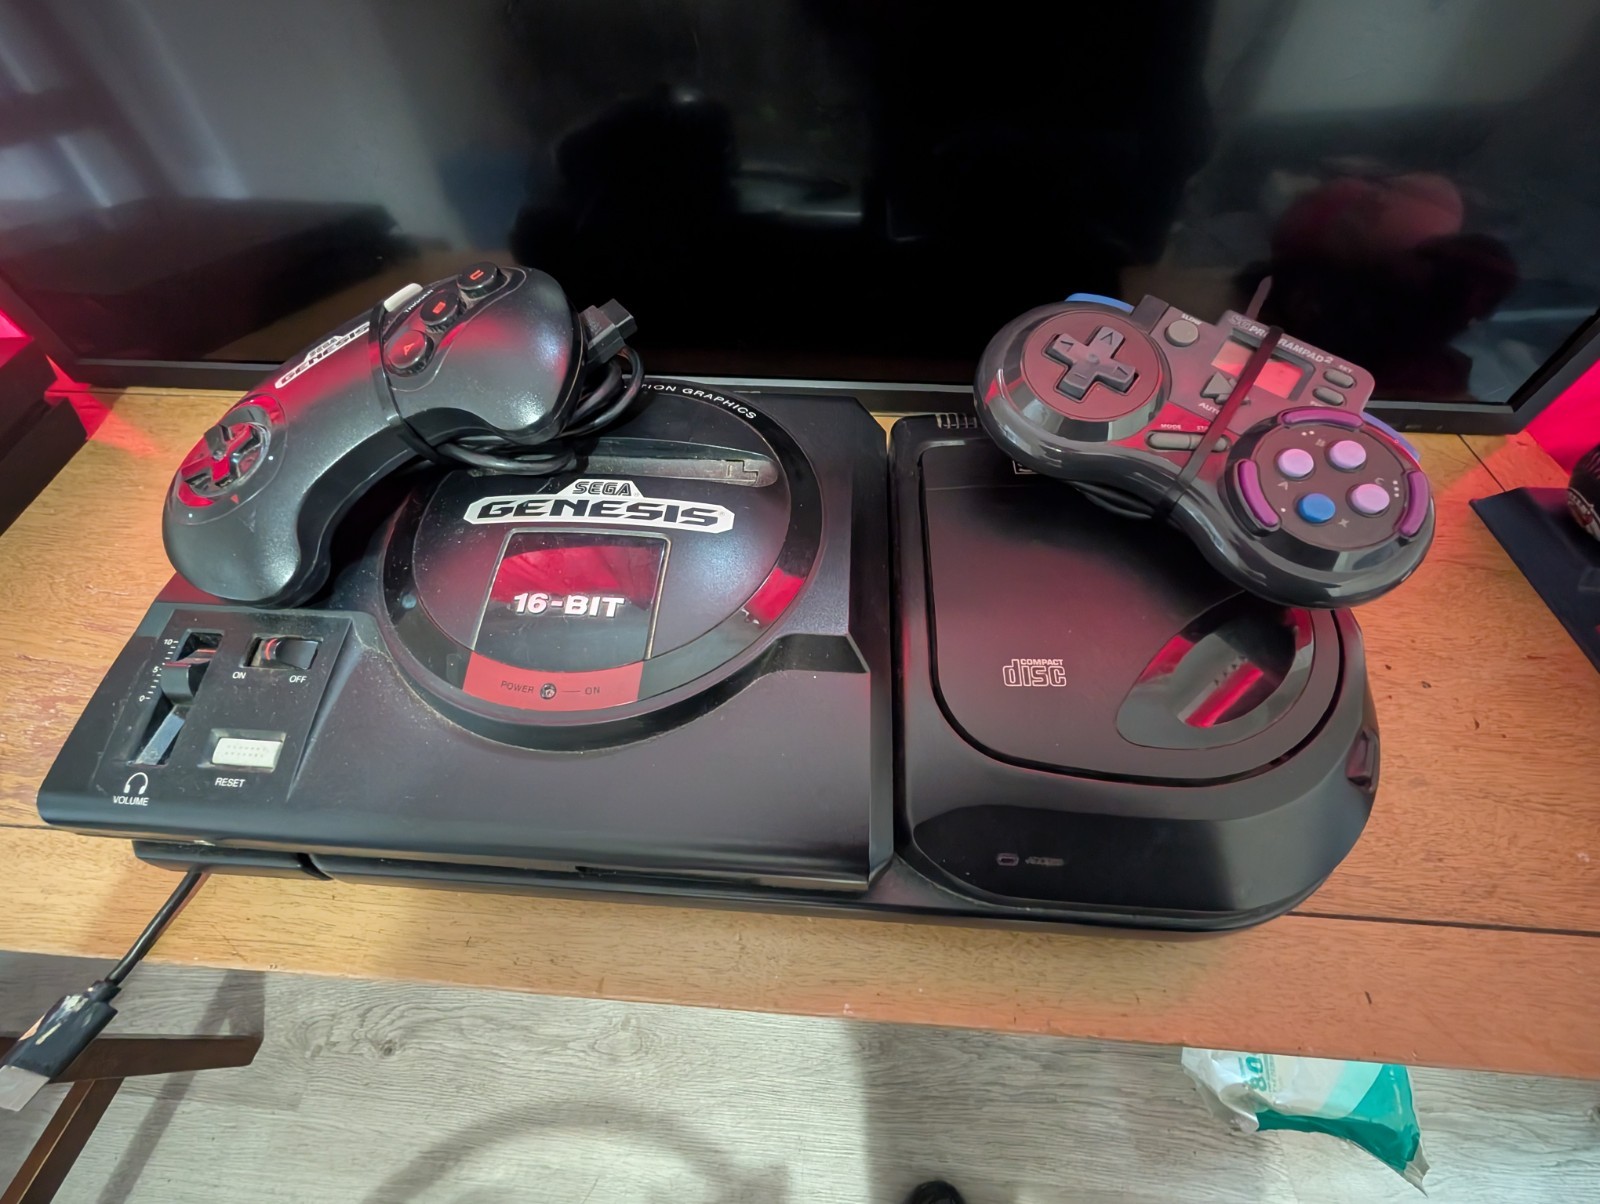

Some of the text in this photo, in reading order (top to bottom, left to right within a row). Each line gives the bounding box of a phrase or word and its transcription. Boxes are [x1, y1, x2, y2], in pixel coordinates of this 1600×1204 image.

[278, 321, 371, 385] GENESIS
[403, 343, 414, 357] A
[681, 388, 757, 420] GRAPHICS
[572, 480, 632, 497] SEGA
[1277, 480, 1289, 491] A
[476, 498, 721, 527] GENESIS
[513, 592, 626, 619] 16-BIT
[1020, 658, 1064, 666] COMPACT
[152, 665, 159, 673] 5
[232, 670, 247, 680] ON
[289, 674, 307, 684] OFF
[500, 680, 601, 696] POWER ON
[214, 777, 246, 788] RESET
[112, 794, 150, 807] VOLUME
